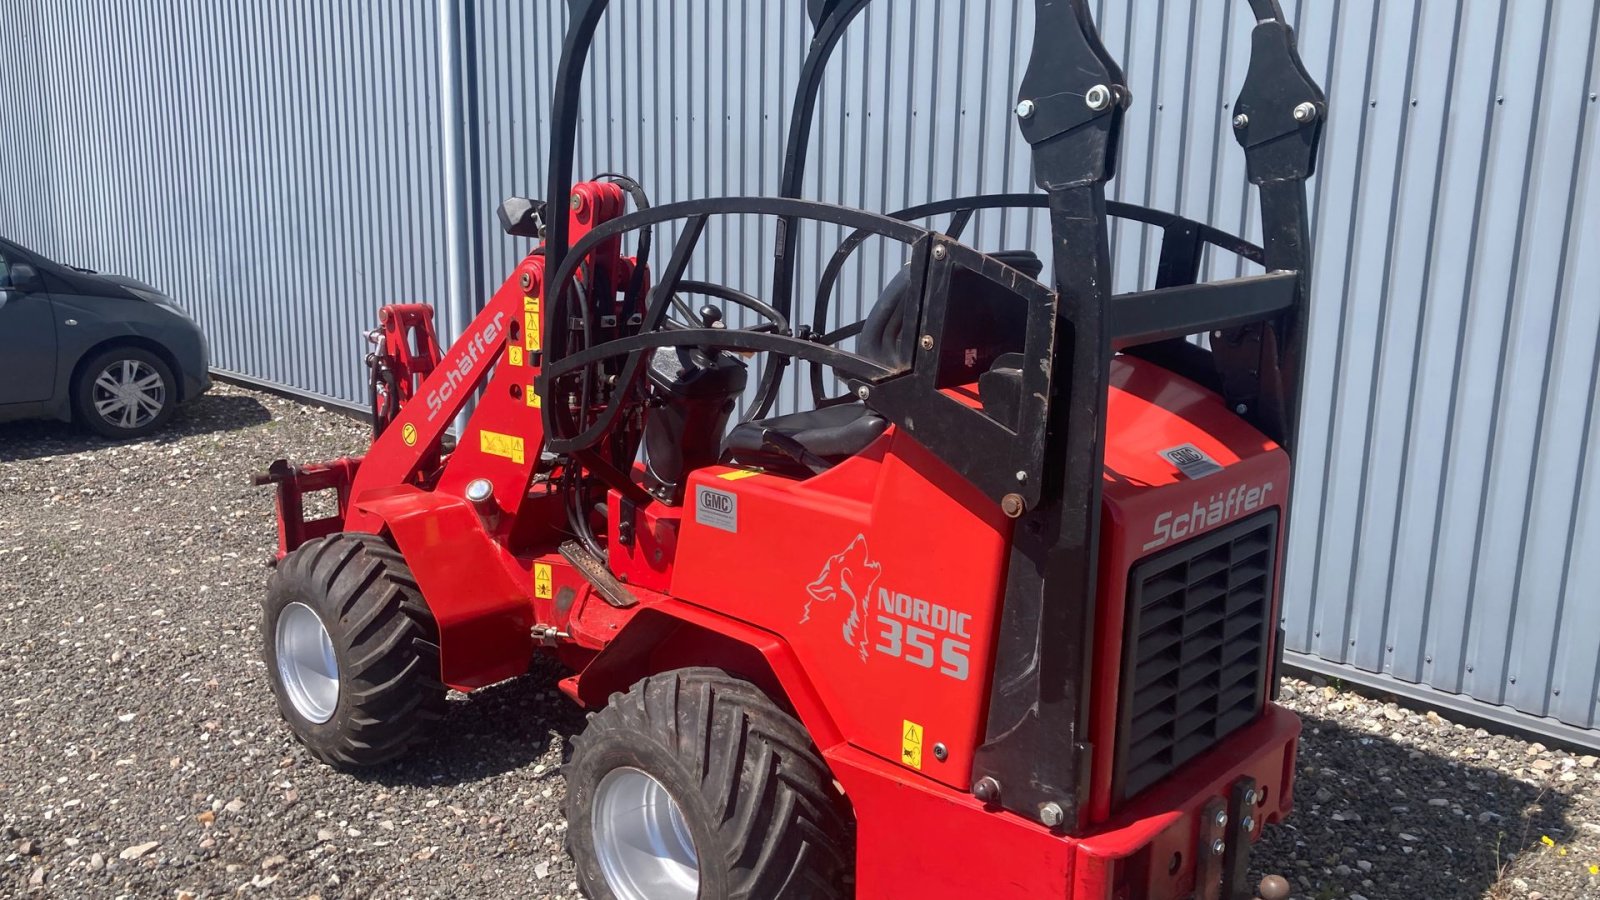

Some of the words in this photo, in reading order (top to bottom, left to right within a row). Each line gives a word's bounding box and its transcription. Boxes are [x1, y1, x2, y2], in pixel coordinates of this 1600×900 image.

[426, 311, 505, 422] Schäffer
[1170, 448, 1200, 464] GMC
[704, 492, 729, 512] GMC
[1142, 481, 1273, 552] Schäffer
[877, 587, 972, 639] NORDIC
